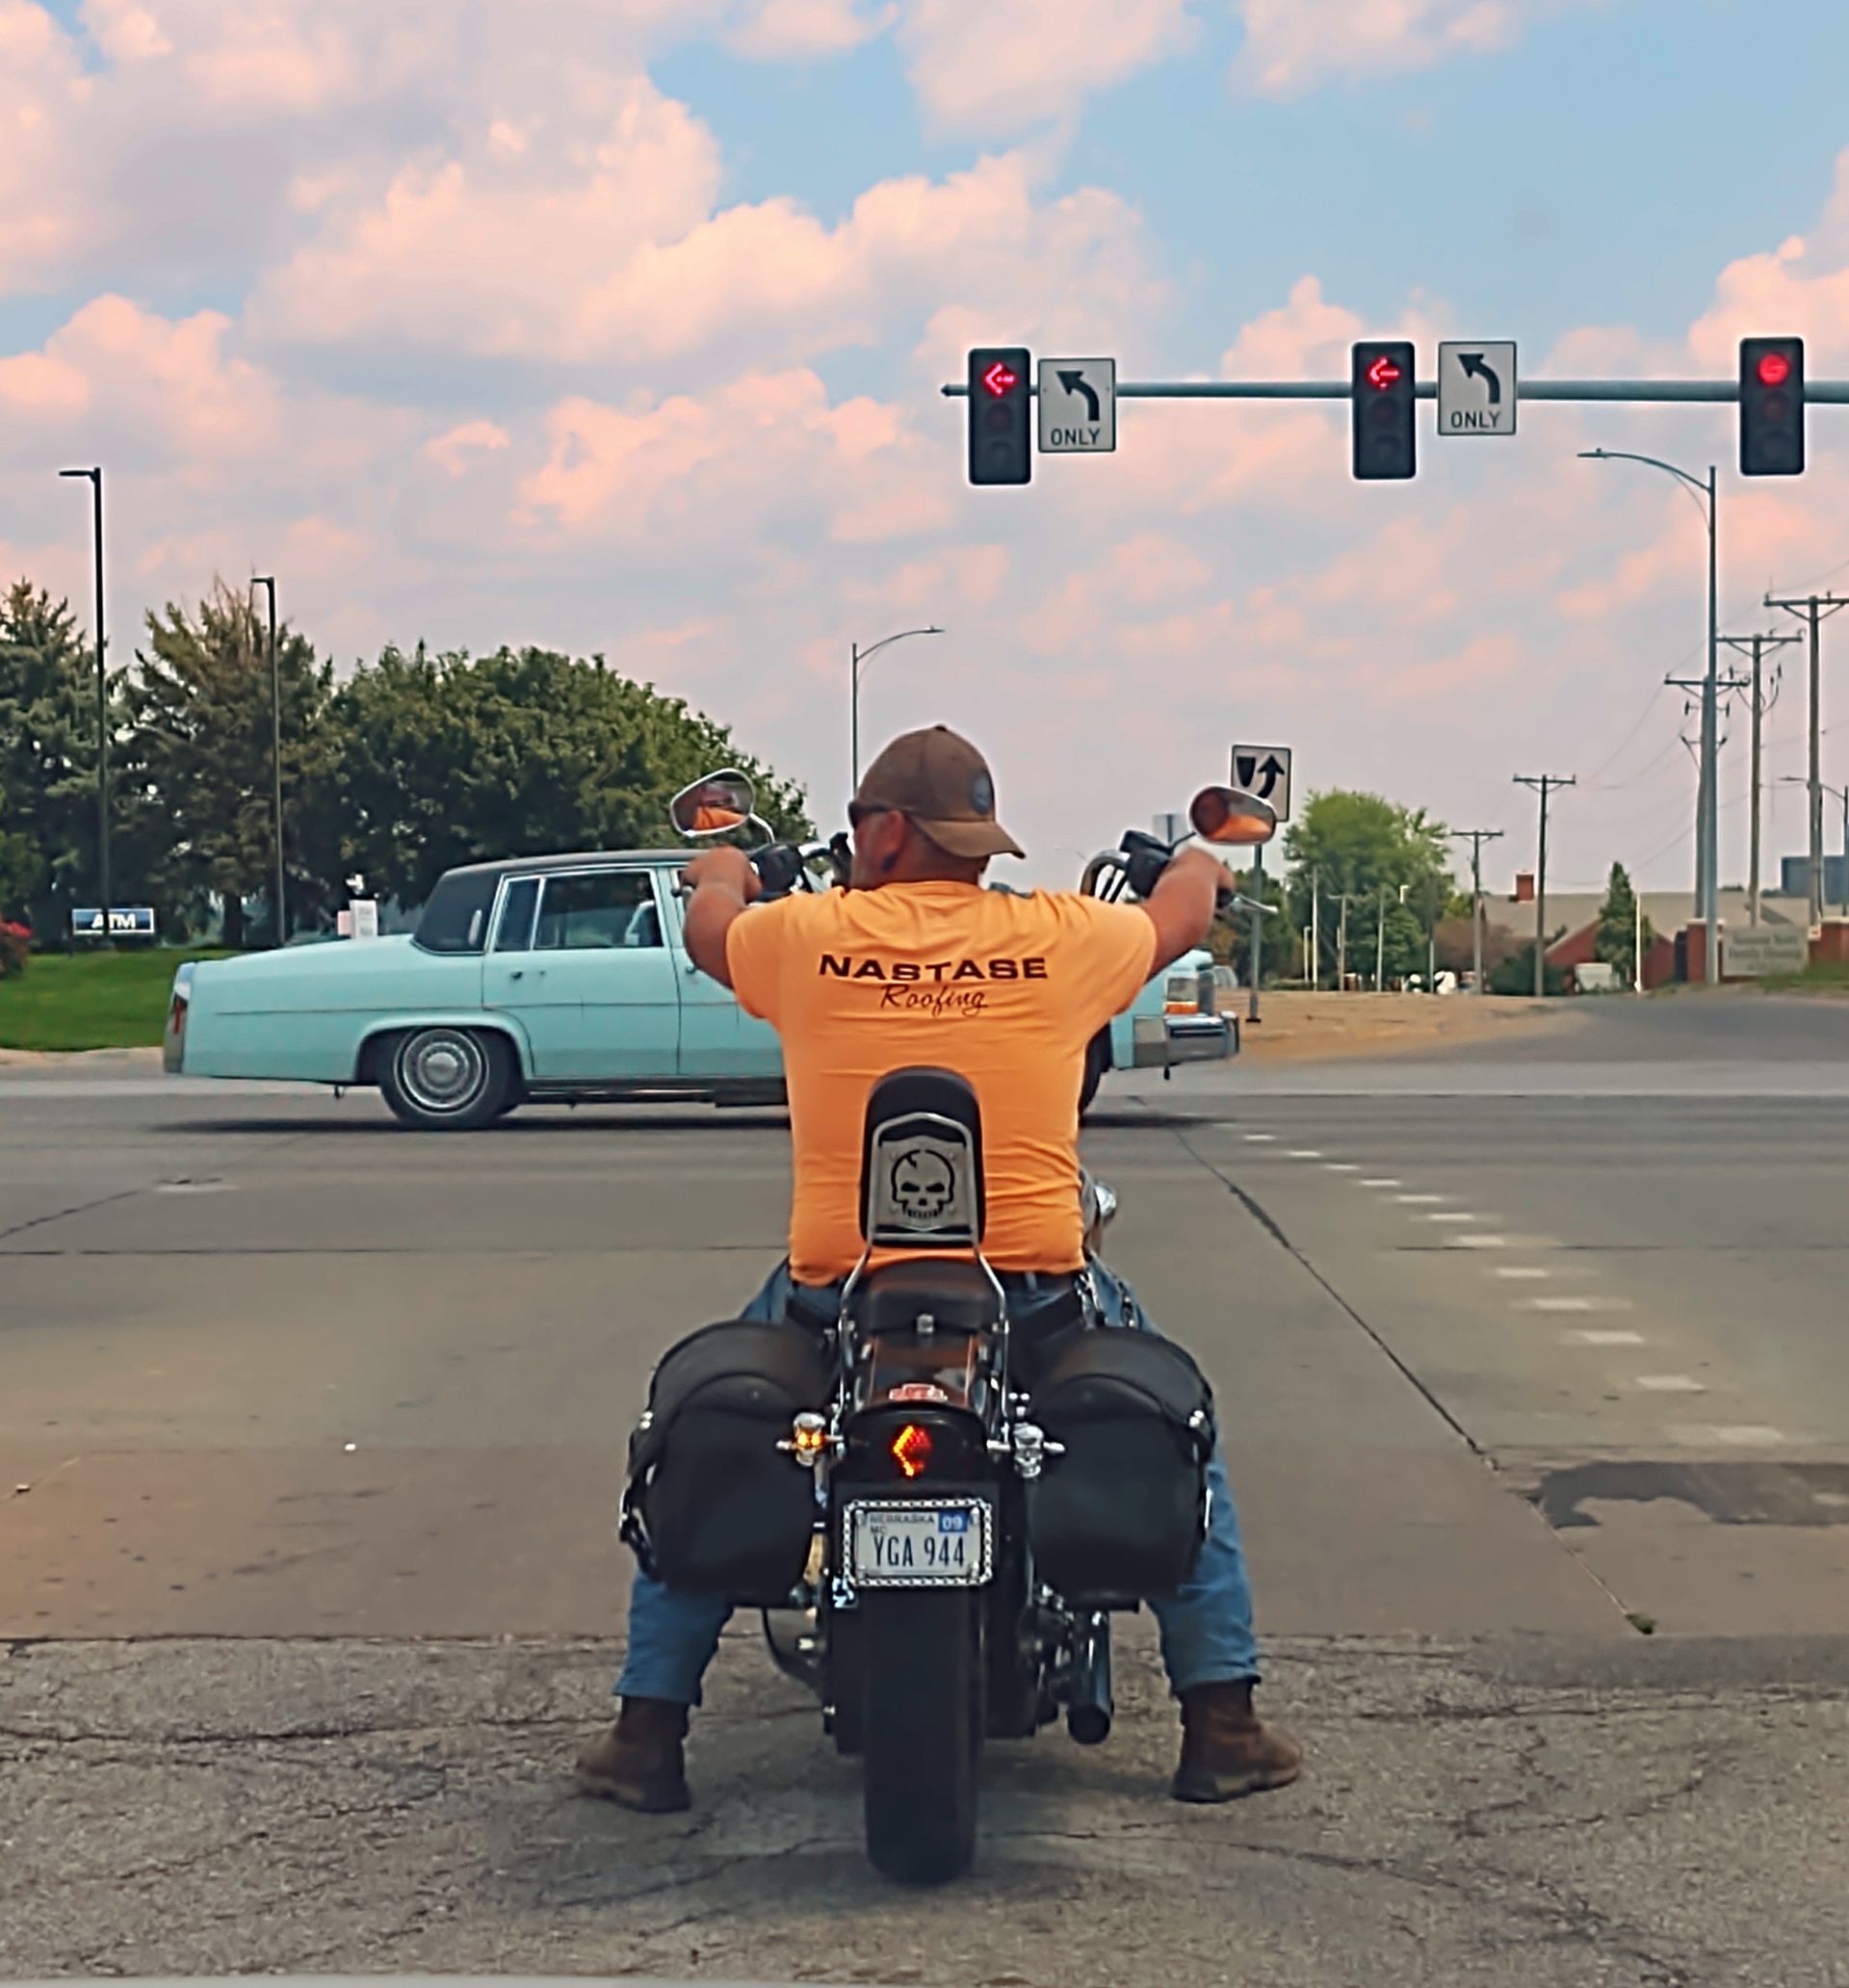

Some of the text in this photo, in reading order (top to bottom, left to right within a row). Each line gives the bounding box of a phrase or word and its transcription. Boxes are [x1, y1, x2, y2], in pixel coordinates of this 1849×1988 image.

[1450, 410, 1501, 429] ONLY
[1051, 428, 1101, 446] ONLY
[91, 912, 137, 929] ATM
[819, 954, 1049, 982] NASTASE
[880, 983, 989, 1017] Roofing
[942, 1515, 963, 1530] 09
[873, 1535, 964, 1567] YGA 944
